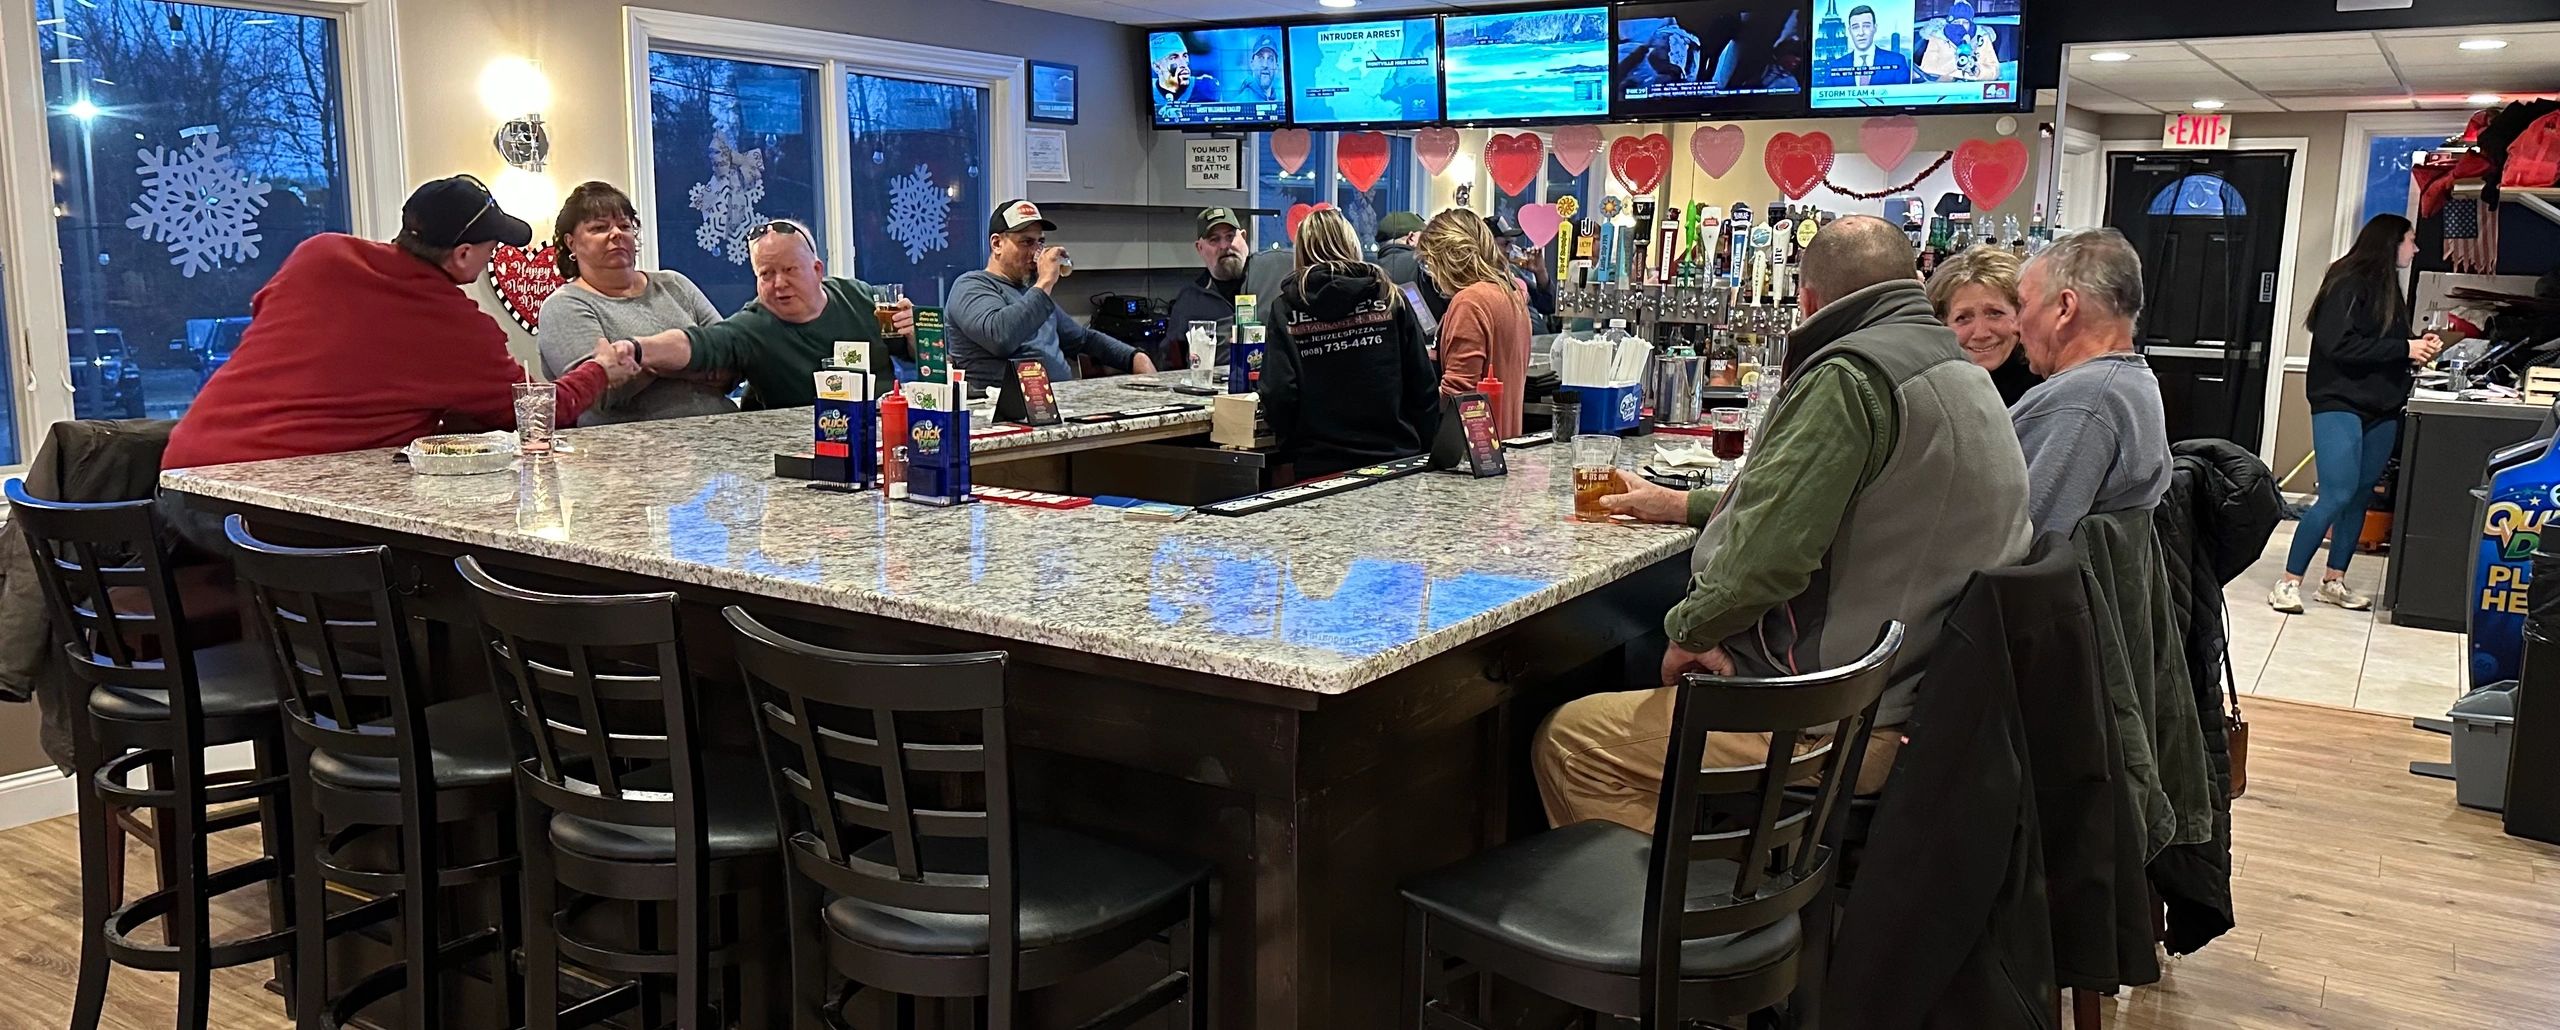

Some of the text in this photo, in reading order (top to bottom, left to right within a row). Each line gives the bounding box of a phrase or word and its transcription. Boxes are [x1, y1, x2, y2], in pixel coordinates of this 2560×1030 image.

[1320, 29, 1400, 41] INTRUDER ARREST
[1819, 90, 1845, 98] STORM
[1848, 89, 1868, 97] TEAM
[2176, 115, 2221, 145] EXIT
[1559, 257, 1566, 265] of
[1774, 247, 1784, 265] Lite
[511, 260, 551, 279] Happy
[518, 294, 543, 311] Da
[1288, 299, 1387, 325] JEE'S
[1301, 335, 1383, 358] (908) 735-4476
[818, 414, 851, 430] Quick
[912, 426, 943, 442] Quick
[2488, 565, 2530, 590] PL
[2481, 588, 2530, 615] HE
